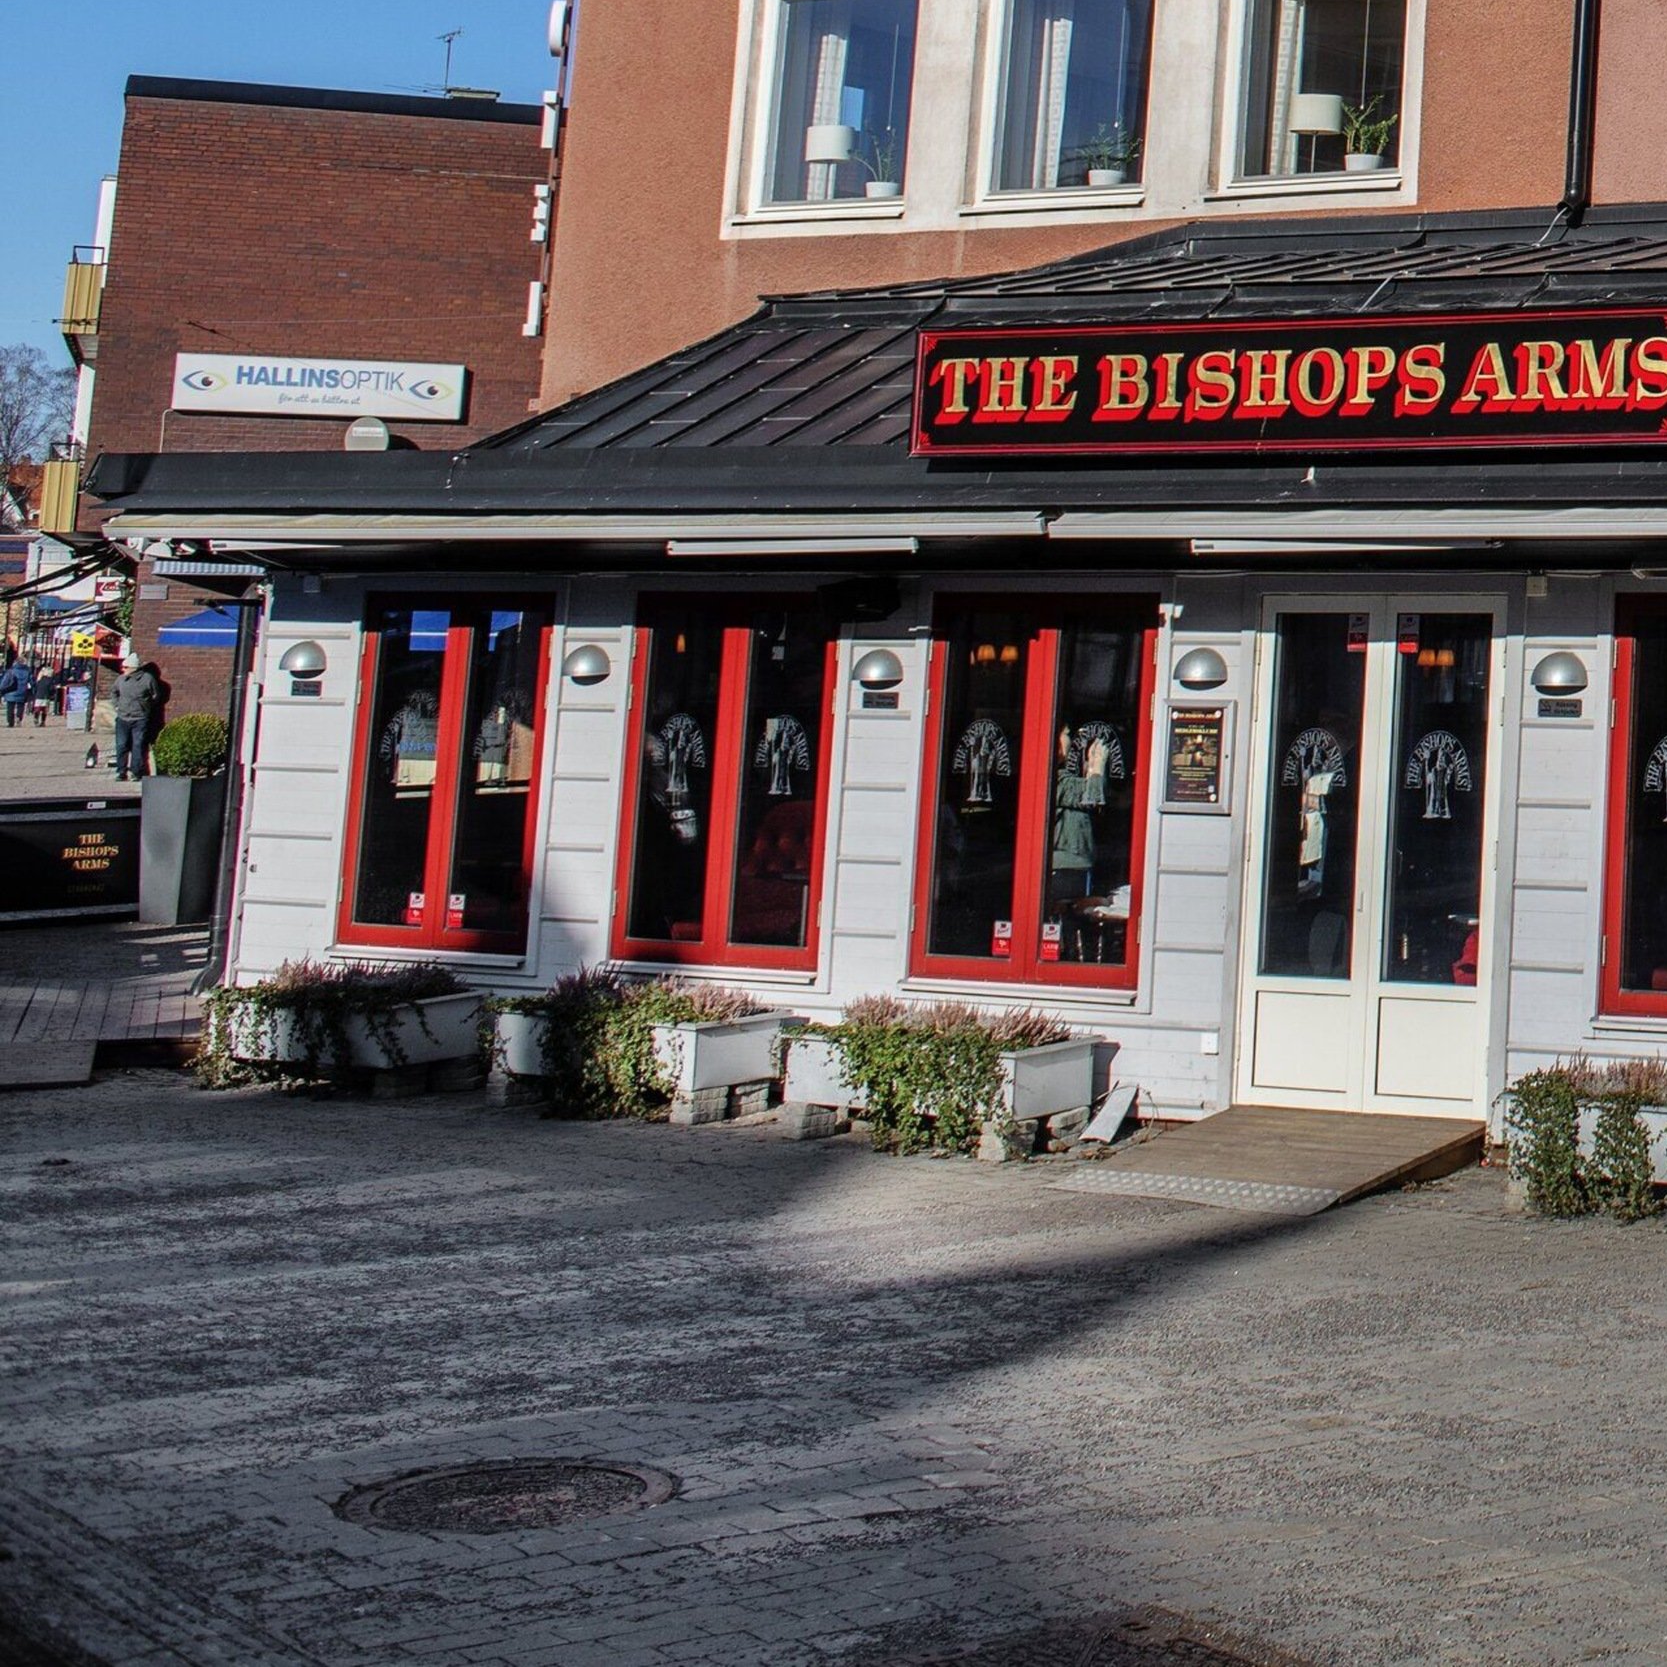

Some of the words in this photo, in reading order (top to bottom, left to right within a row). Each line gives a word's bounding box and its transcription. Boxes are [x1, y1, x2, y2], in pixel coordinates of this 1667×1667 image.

[932, 355, 1079, 425] THE
[1092, 342, 1446, 424] BISHOPS
[1291, 731, 1331, 759] BISHOPS
[1284, 756, 1299, 783] THE
[1407, 758, 1421, 785] THE
[1414, 733, 1457, 762] BISHOPS
[1452, 749, 1470, 786] ARMS
[1645, 760, 1661, 788] THE
[62, 845, 119, 859] BISHOPS
[79, 834, 105, 845] THE
[73, 858, 110, 870] ARMS
